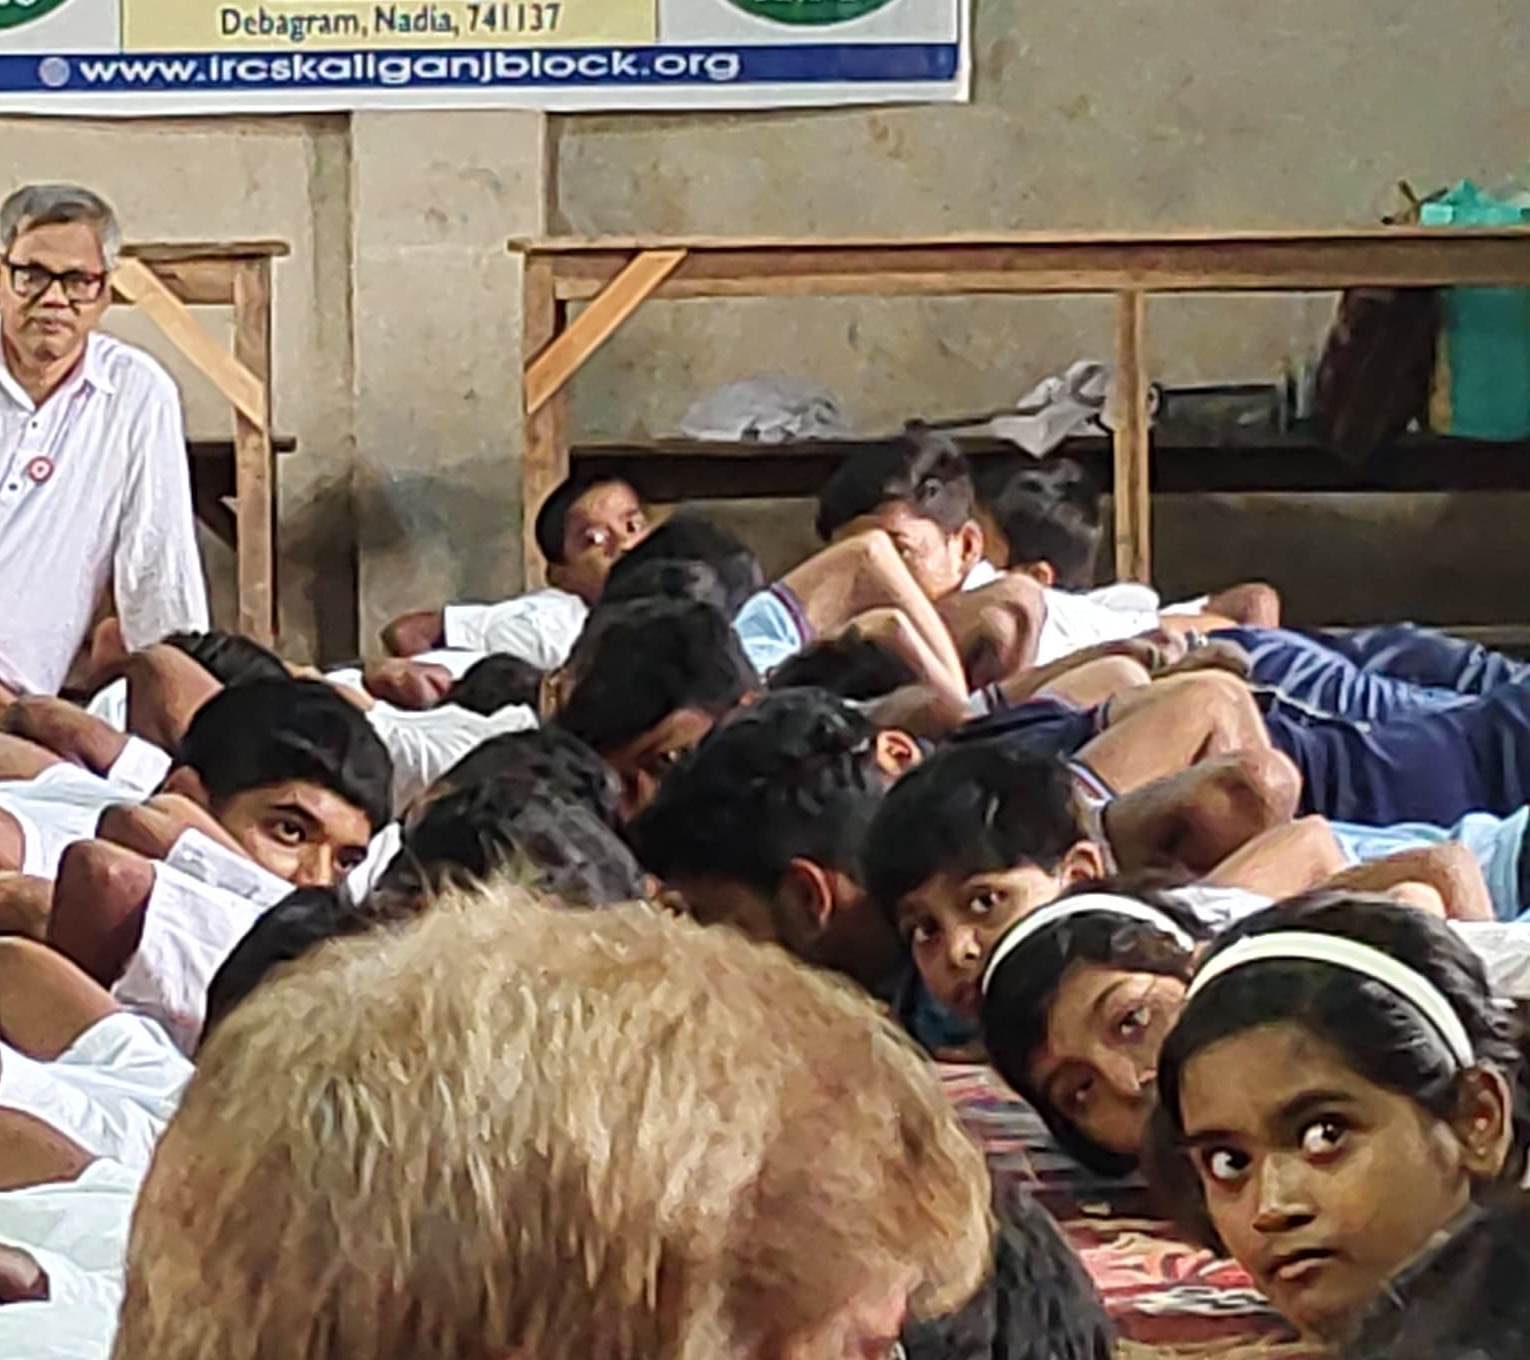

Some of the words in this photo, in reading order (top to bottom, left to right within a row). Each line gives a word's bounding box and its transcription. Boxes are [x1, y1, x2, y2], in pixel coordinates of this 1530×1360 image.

[222, 8, 367, 41] Debagram,
[374, 5, 459, 37] Nadia,
[467, 4, 560, 33] 741137
[79, 48, 741, 86] www.ircskaliganjblock.org
